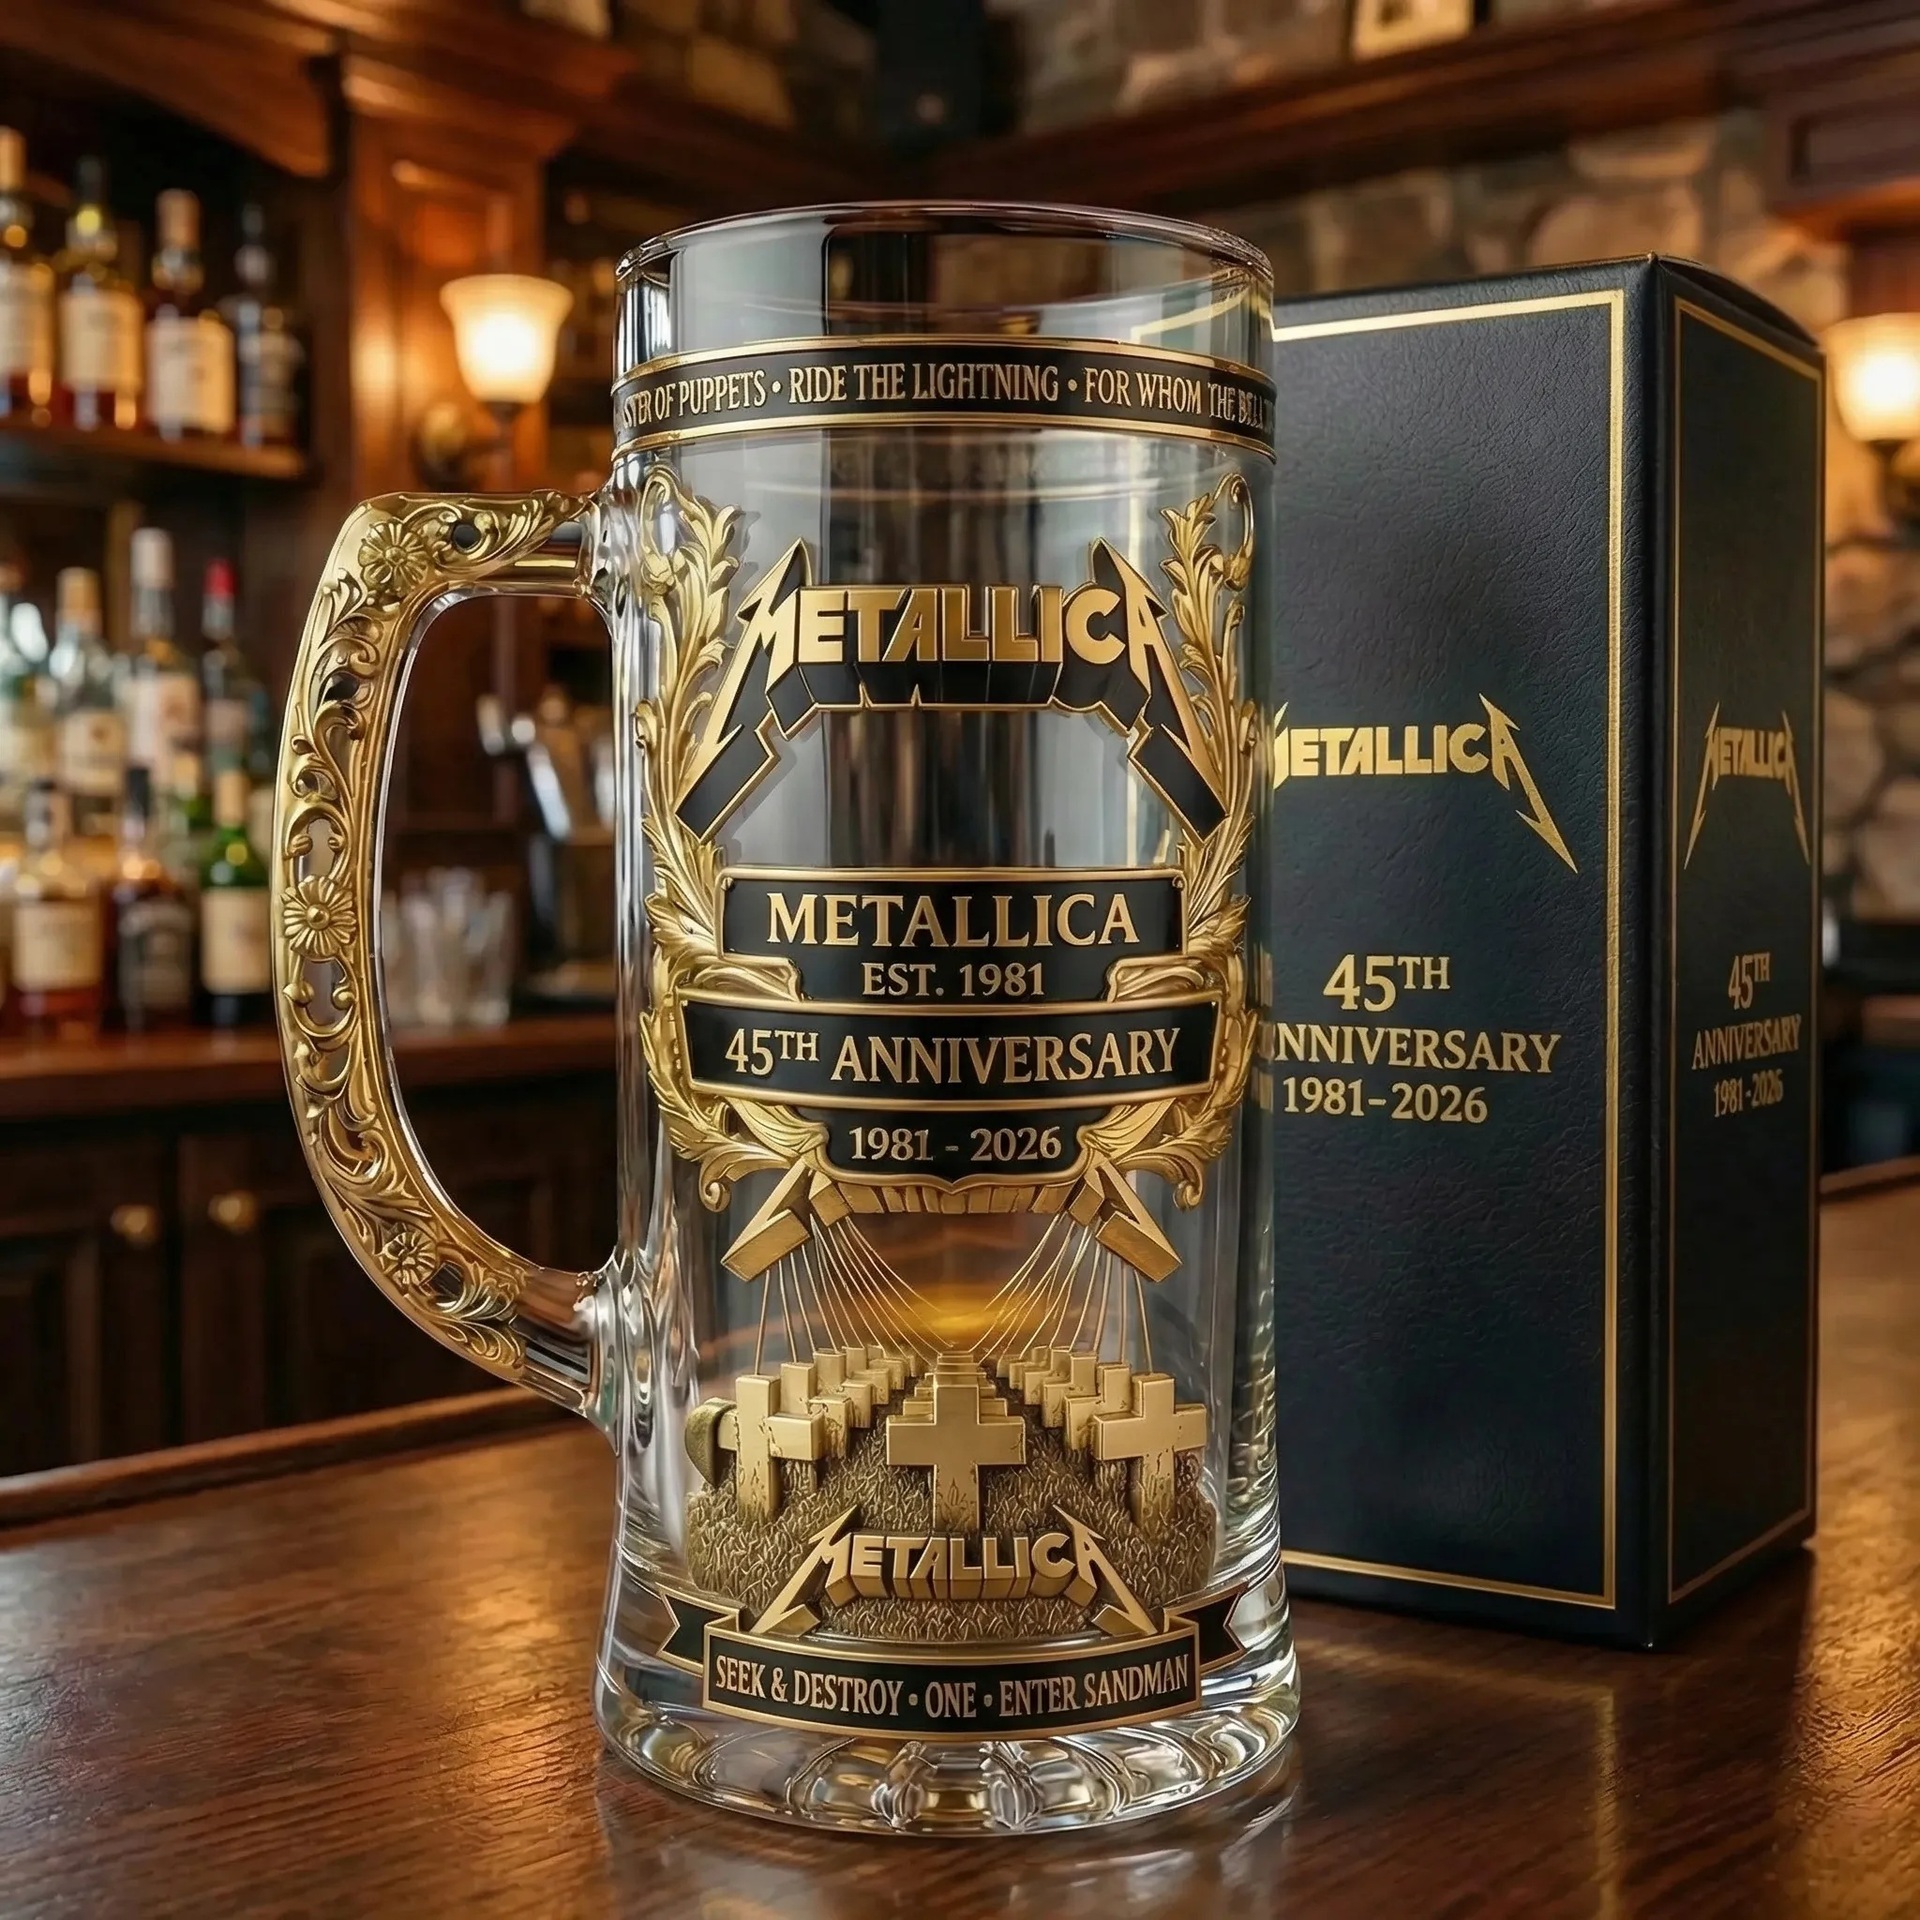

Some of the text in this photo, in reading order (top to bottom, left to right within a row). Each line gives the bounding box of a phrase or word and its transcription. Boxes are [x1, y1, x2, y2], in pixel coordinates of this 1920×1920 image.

[654, 382, 676, 420] OF
[678, 368, 767, 418] PUPPETS
[788, 364, 848, 405] RIDE
[853, 362, 906, 401] THE
[911, 362, 1059, 402] LIGHTNING
[1084, 366, 1131, 407] FOR
[1135, 371, 1201, 416] WHOM
[1207, 382, 1236, 421] THE
[675, 538, 1229, 842] METALLICA
[766, 892, 1141, 948] METALLICA
[861, 962, 1045, 997] EST. 1981
[1323, 954, 1450, 1013] 45TH
[1728, 952, 1770, 1011] 45TH
[725, 1028, 1181, 1085] 45TH ANNIVERSARY
[1274, 1022, 1562, 1073] NNIVERSARY
[1691, 1013, 1801, 1070] ANNIVERSARY
[1283, 1076, 1489, 1124] 1981-2026
[849, 1127, 934, 1162] 1981
[970, 1126, 1062, 1162] 2026
[749, 1504, 1158, 1637] METALLICA
[715, 1654, 1190, 1720] SEEK & DESTROY ONE ENTER SANDMAN
